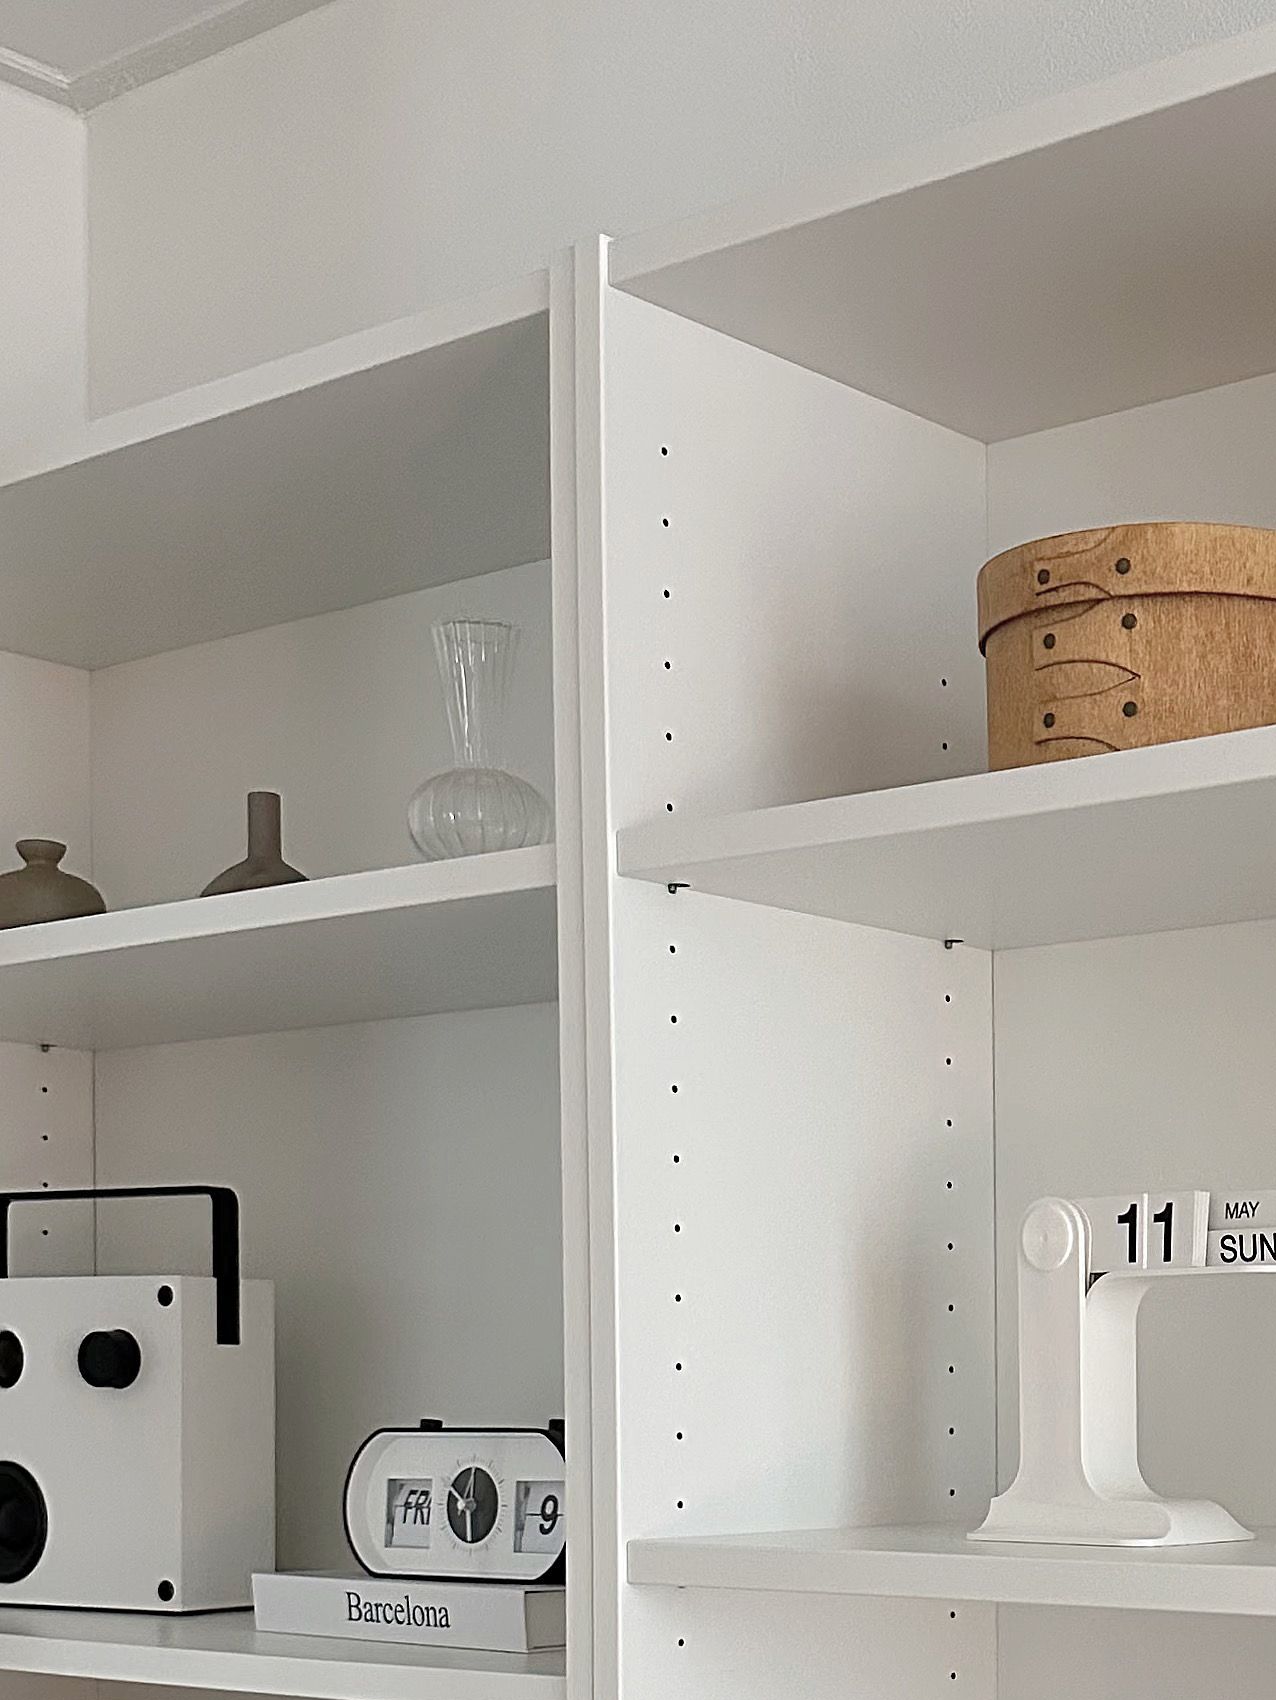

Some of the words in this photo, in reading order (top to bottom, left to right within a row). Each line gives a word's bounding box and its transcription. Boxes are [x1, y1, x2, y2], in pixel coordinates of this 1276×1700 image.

[1225, 1201, 1260, 1220] MAY
[539, 1494, 560, 1536] 9
[345, 1590, 451, 1629] Barcelona
